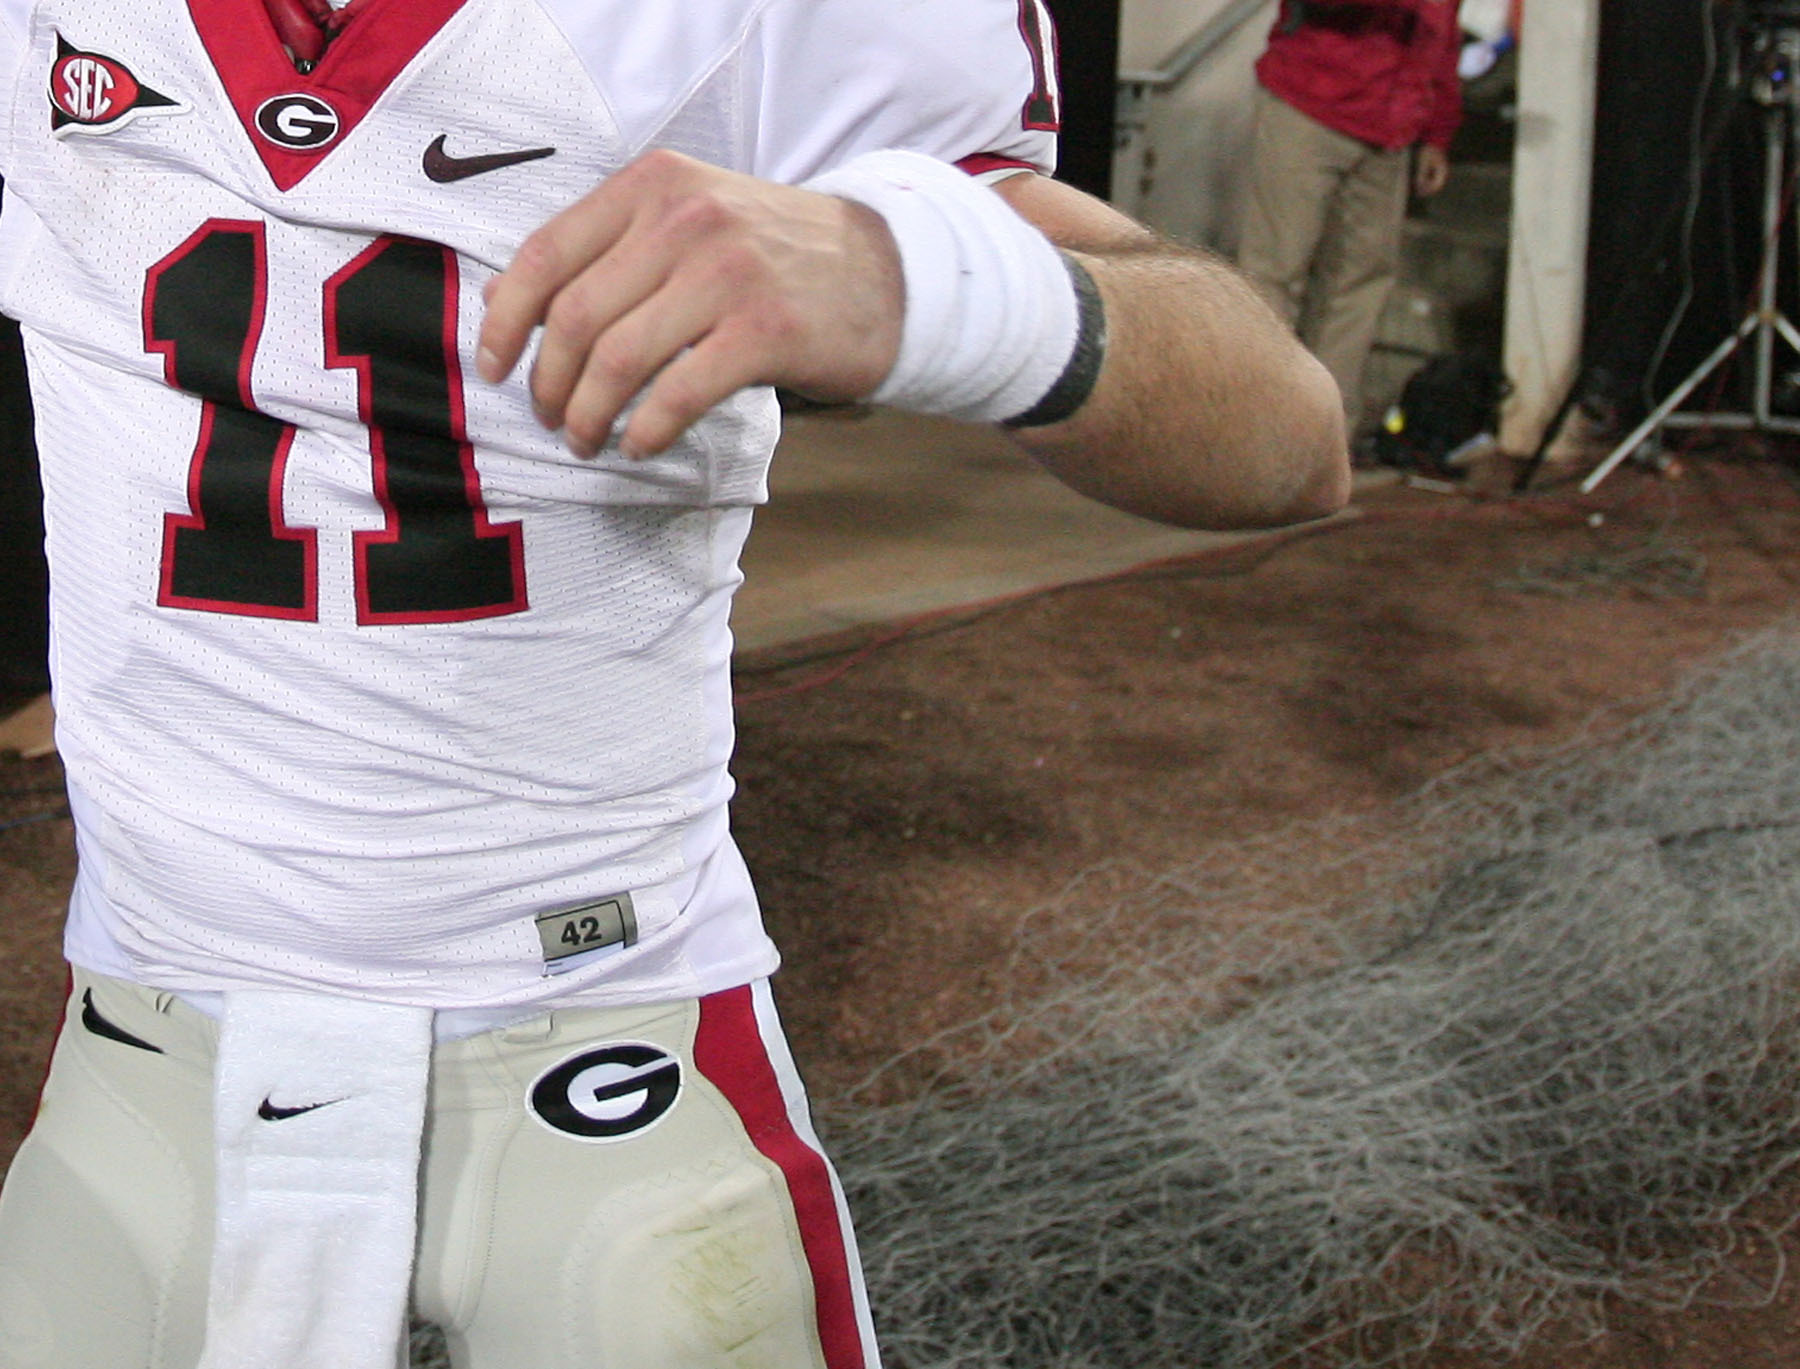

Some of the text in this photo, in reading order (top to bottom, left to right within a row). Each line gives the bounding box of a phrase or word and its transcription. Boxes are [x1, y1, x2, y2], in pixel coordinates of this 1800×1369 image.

[63, 58, 115, 120] SEC
[257, 96, 337, 148] G
[142, 217, 530, 627] 11
[560, 915, 603, 947] 42
[531, 1044, 681, 1138] G
